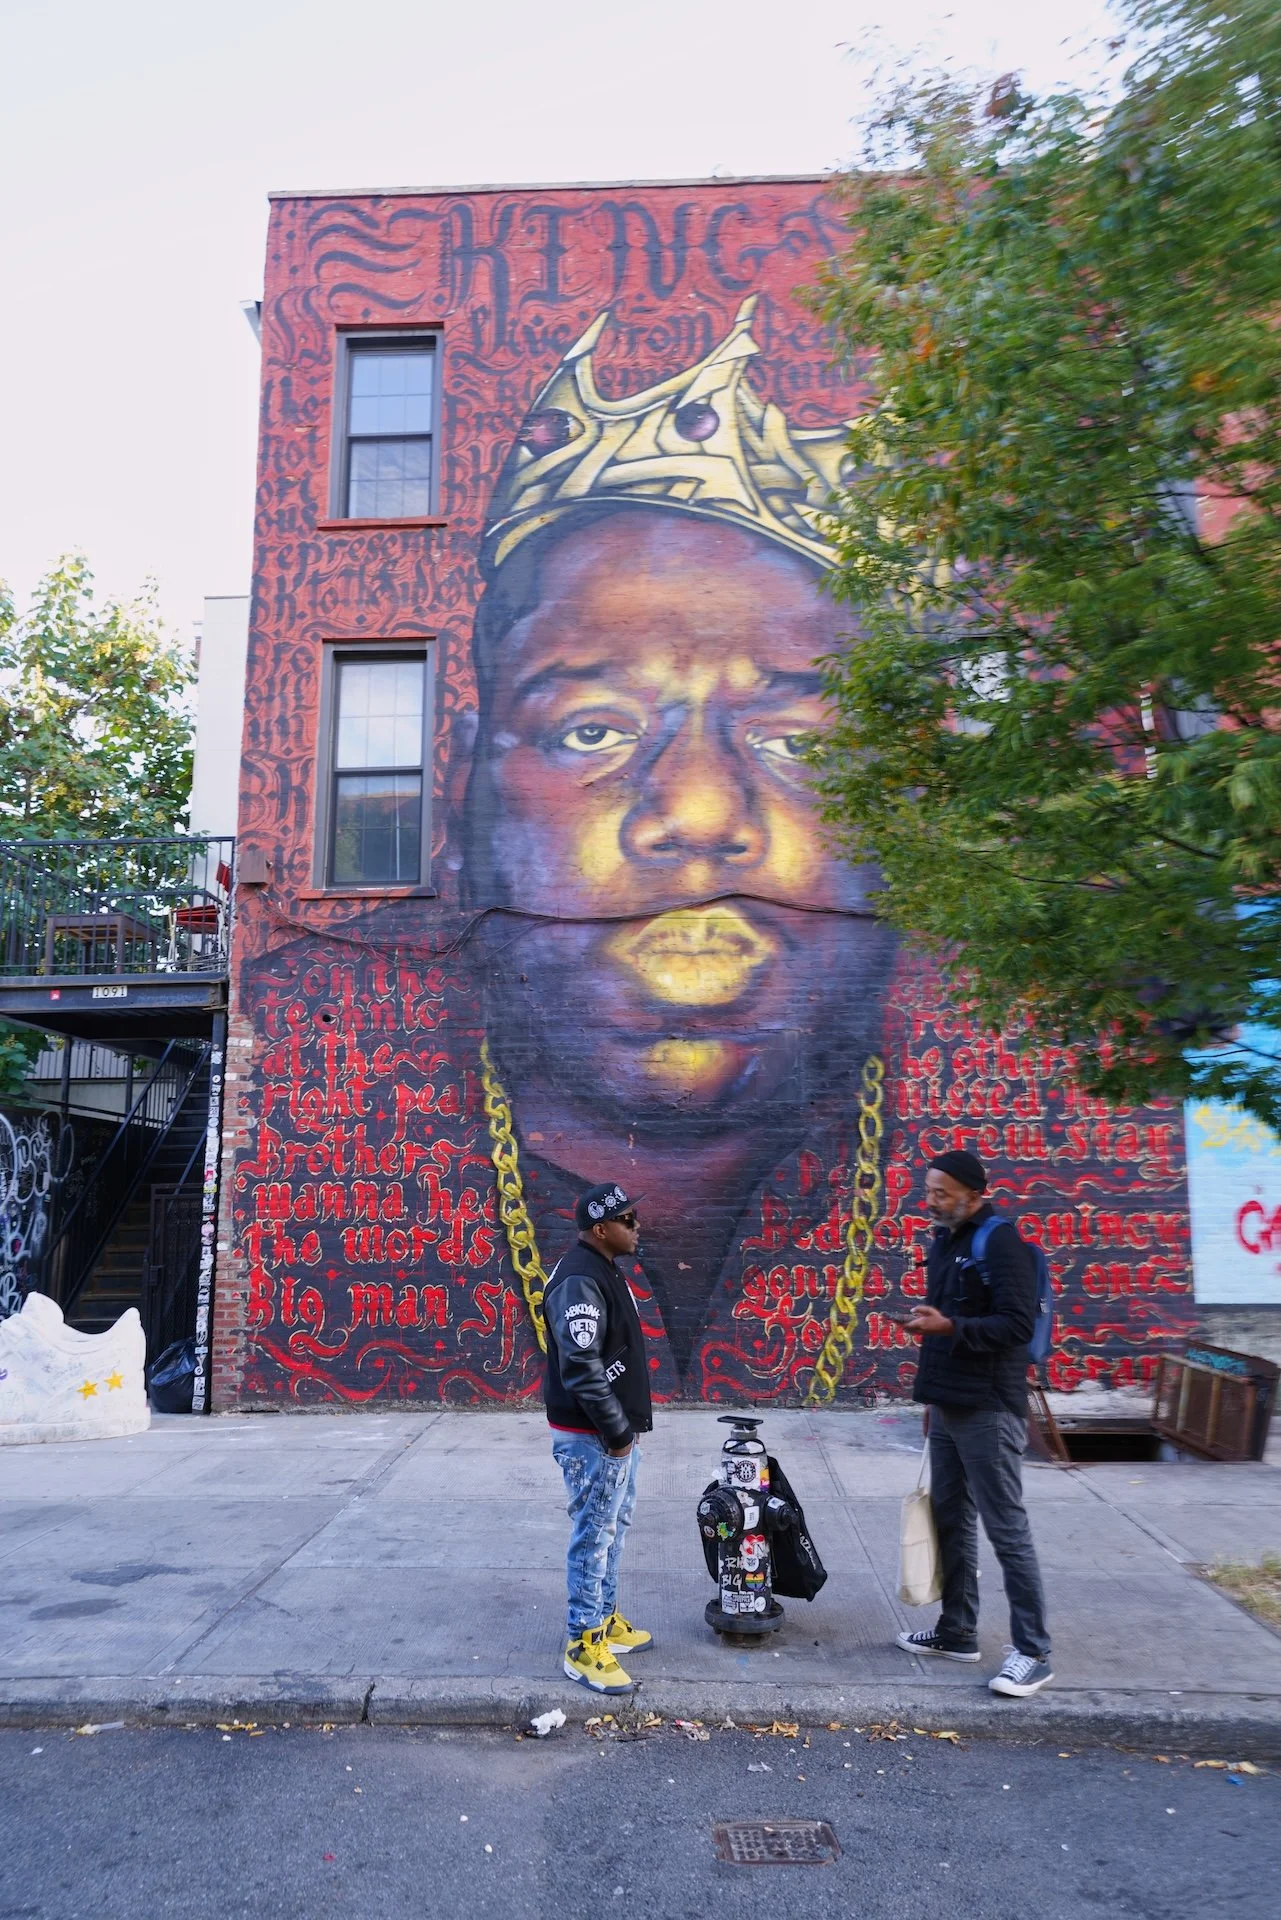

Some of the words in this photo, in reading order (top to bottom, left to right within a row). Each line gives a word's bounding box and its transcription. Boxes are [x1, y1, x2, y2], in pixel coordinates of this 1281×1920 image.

[448, 196, 758, 318] KING
[95, 987, 125, 997] 1091
[262, 1033, 314, 1079] at
[316, 1028, 394, 1080] the
[257, 1069, 373, 1134] right
[247, 1262, 350, 1361] Big
[347, 1280, 453, 1334] man
[570, 1320, 597, 1333] NETS
[725, 1554, 744, 1571] RI
[722, 1573, 742, 1590] BIG
